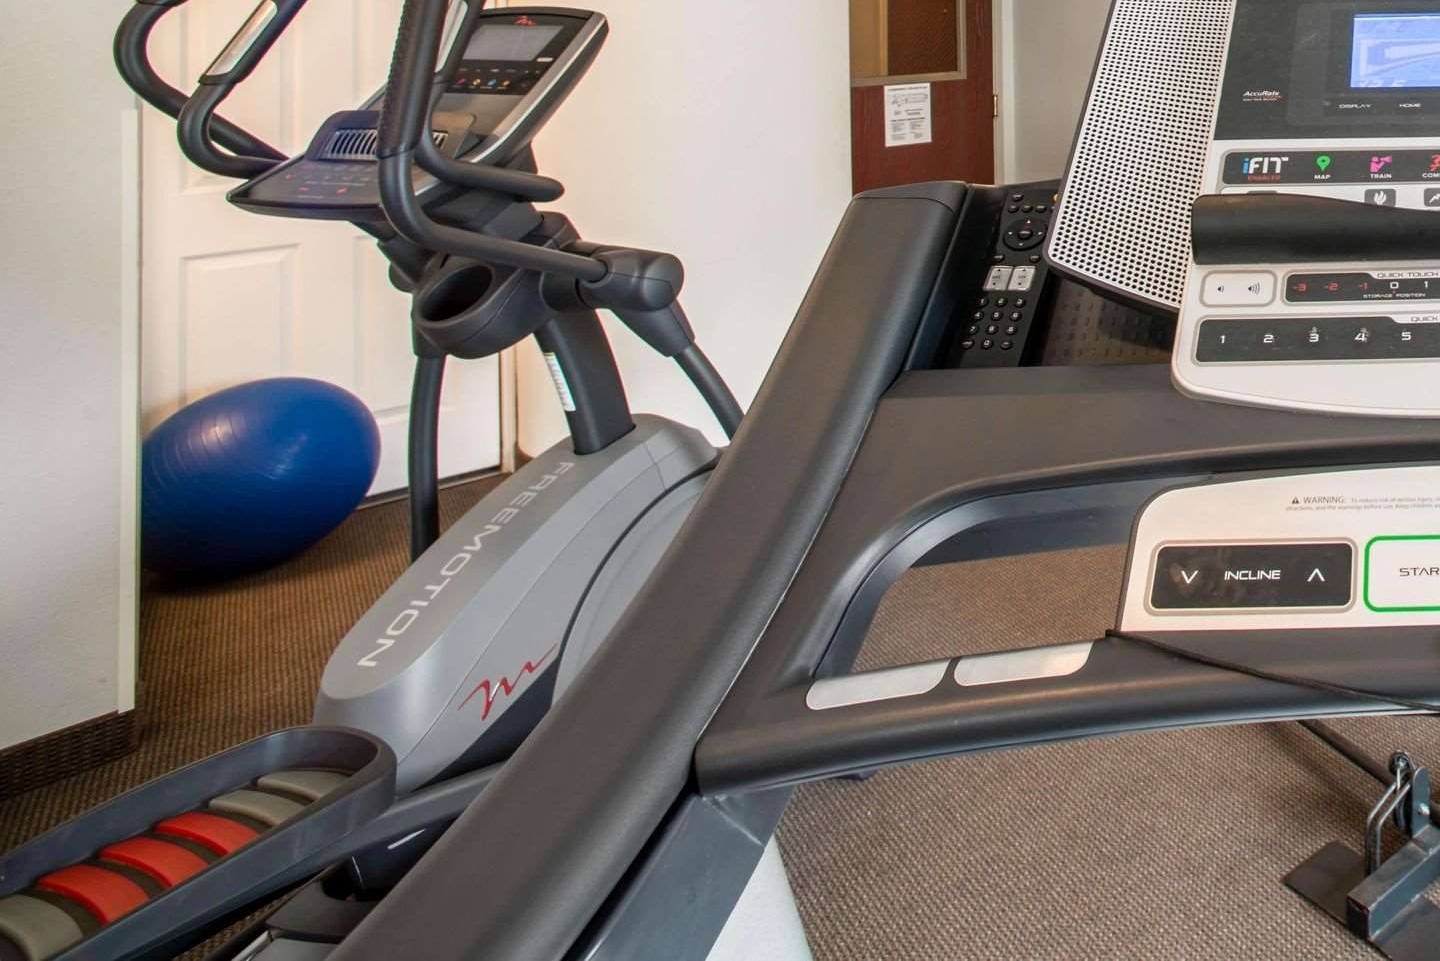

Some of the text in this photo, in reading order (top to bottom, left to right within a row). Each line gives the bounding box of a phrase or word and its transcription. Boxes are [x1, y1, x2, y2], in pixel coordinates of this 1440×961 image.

[1293, 283, 1307, 291] -3
[1324, 282, 1339, 290] -2
[1389, 281, 1399, 289] 0
[1219, 335, 1225, 344] 1
[1263, 334, 1274, 343] 2
[1309, 333, 1320, 343] 3
[1354, 332, 1366, 342] 4
[1401, 331, 1412, 341] 5
[357, 461, 576, 668] FREEMOTION
[1223, 568, 1282, 582] INCLINE
